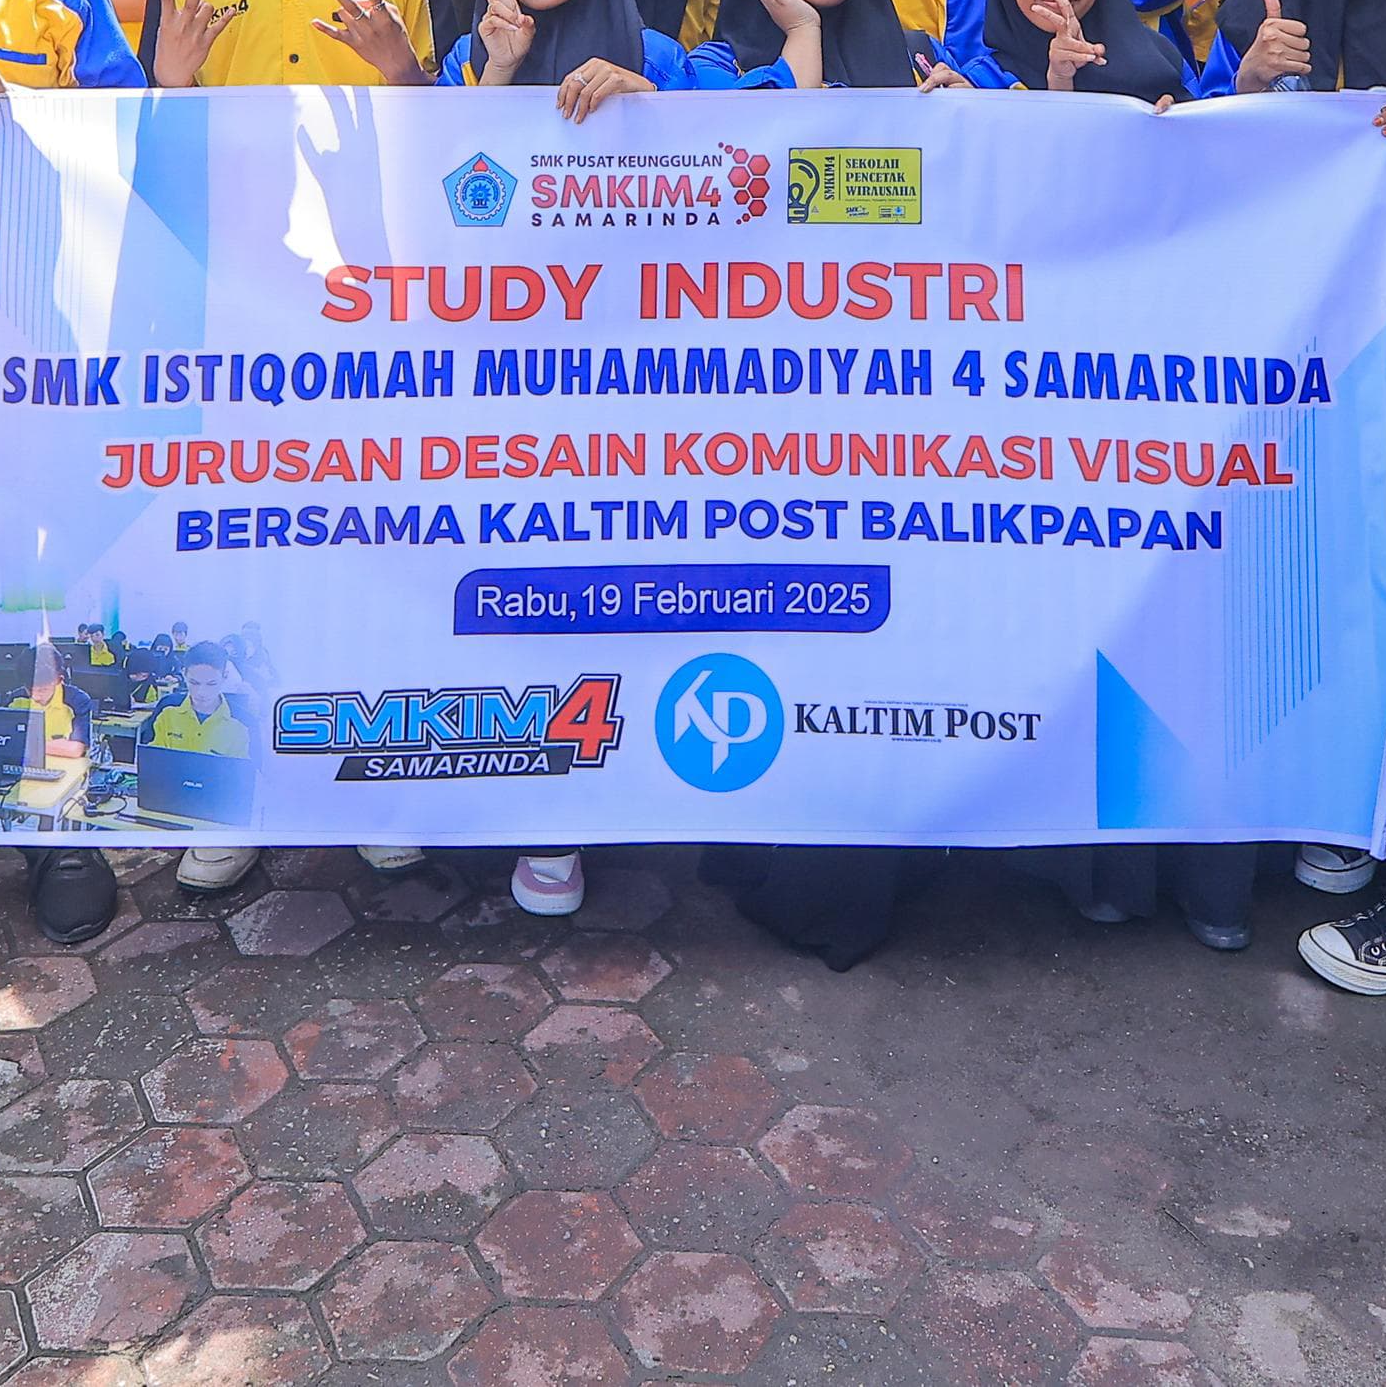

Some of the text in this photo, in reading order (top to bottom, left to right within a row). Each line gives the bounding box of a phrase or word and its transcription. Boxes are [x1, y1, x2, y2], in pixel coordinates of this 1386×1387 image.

[530, 154, 722, 168] SMK PUSAT KEUNGGULAN
[845, 158, 900, 169] SEKOLAH
[845, 172, 906, 183] PENCETAK
[531, 173, 722, 209] SMKIM4
[845, 186, 917, 197] WIRAUSAHA
[530, 212, 721, 227] SAMARINDA
[320, 261, 1024, 322] STUDY INDUSTRI
[2, 347, 1332, 406] SMK ISTIQOMAH MUHAMMADIYAH 4 SAMARINDA
[101, 432, 1293, 489] JURUSAN DESAIN KOMUNIKASI VISUAL
[175, 499, 1223, 552] BERSAMA KALTIM POST BALIKPAPAN
[633, 582, 774, 615] Februari
[784, 581, 871, 615] 2025
[274, 673, 623, 767] SMKIM4
[794, 702, 1041, 741] KALTIM POST
[364, 751, 551, 778] SAMARINDA
